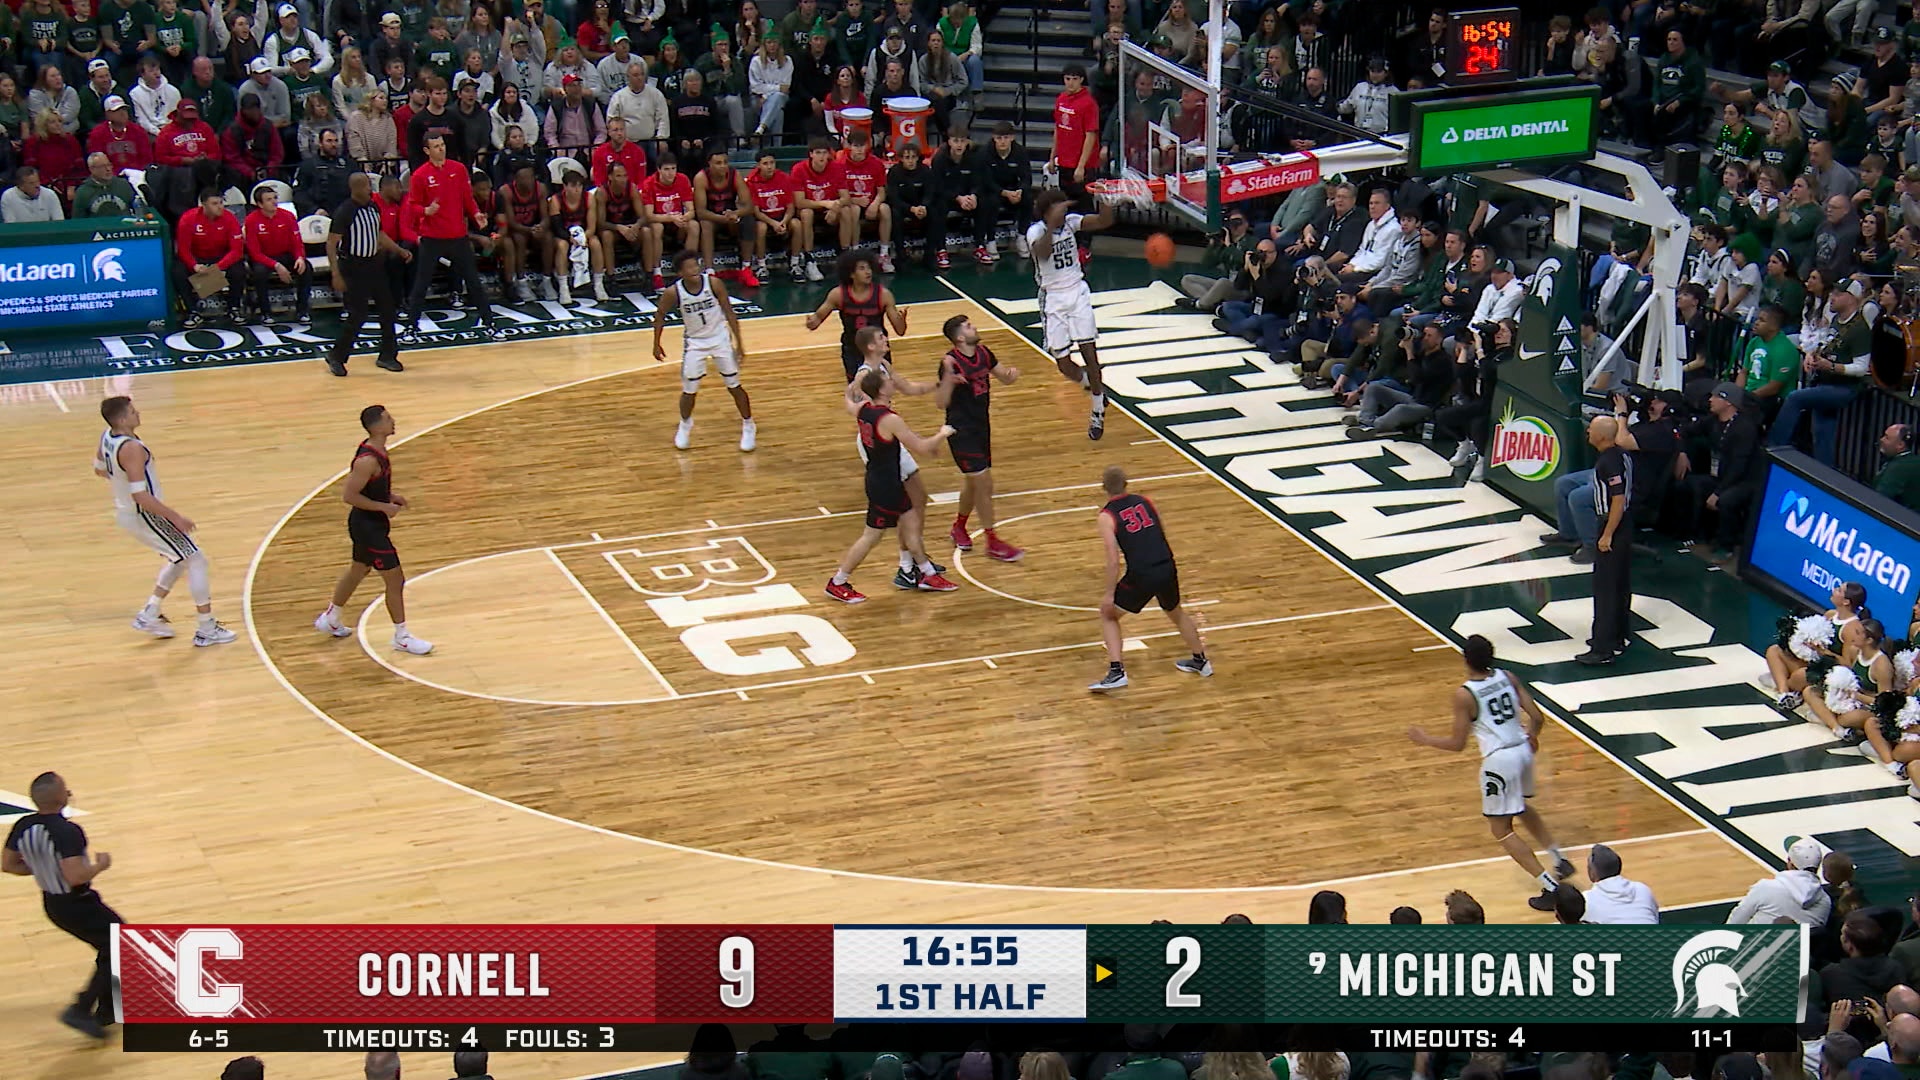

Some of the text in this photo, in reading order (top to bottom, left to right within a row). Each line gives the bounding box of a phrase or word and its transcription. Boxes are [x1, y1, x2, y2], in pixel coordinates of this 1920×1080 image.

[1463, 20, 1511, 43] 16:54
[1466, 46, 1498, 73] 24
[900, 119, 915, 137] G
[1463, 120, 1569, 142] DELTA DENTAL
[1247, 169, 1313, 191] StateFarm
[106, 230, 157, 240] ACRISURE
[1053, 250, 1073, 270] 55
[44, 293, 79, 304] SPORTS
[79, 290, 120, 301] MEDICINE
[121, 287, 159, 299] PARTNER
[44, 302, 69, 313] STATE
[70, 300, 114, 311] ATHLETICS
[683, 298, 715, 314] STATE
[698, 312, 707, 326] 1
[92, 322, 336, 360] FOR
[107, 356, 176, 370] THE
[181, 346, 313, 365] CAPITAL
[544, 316, 605, 333] MSU
[1491, 424, 1556, 467] LIBMAN
[1119, 503, 1154, 533] 31
[1809, 511, 1912, 595] McLaren
[1488, 692, 1516, 725] 99
